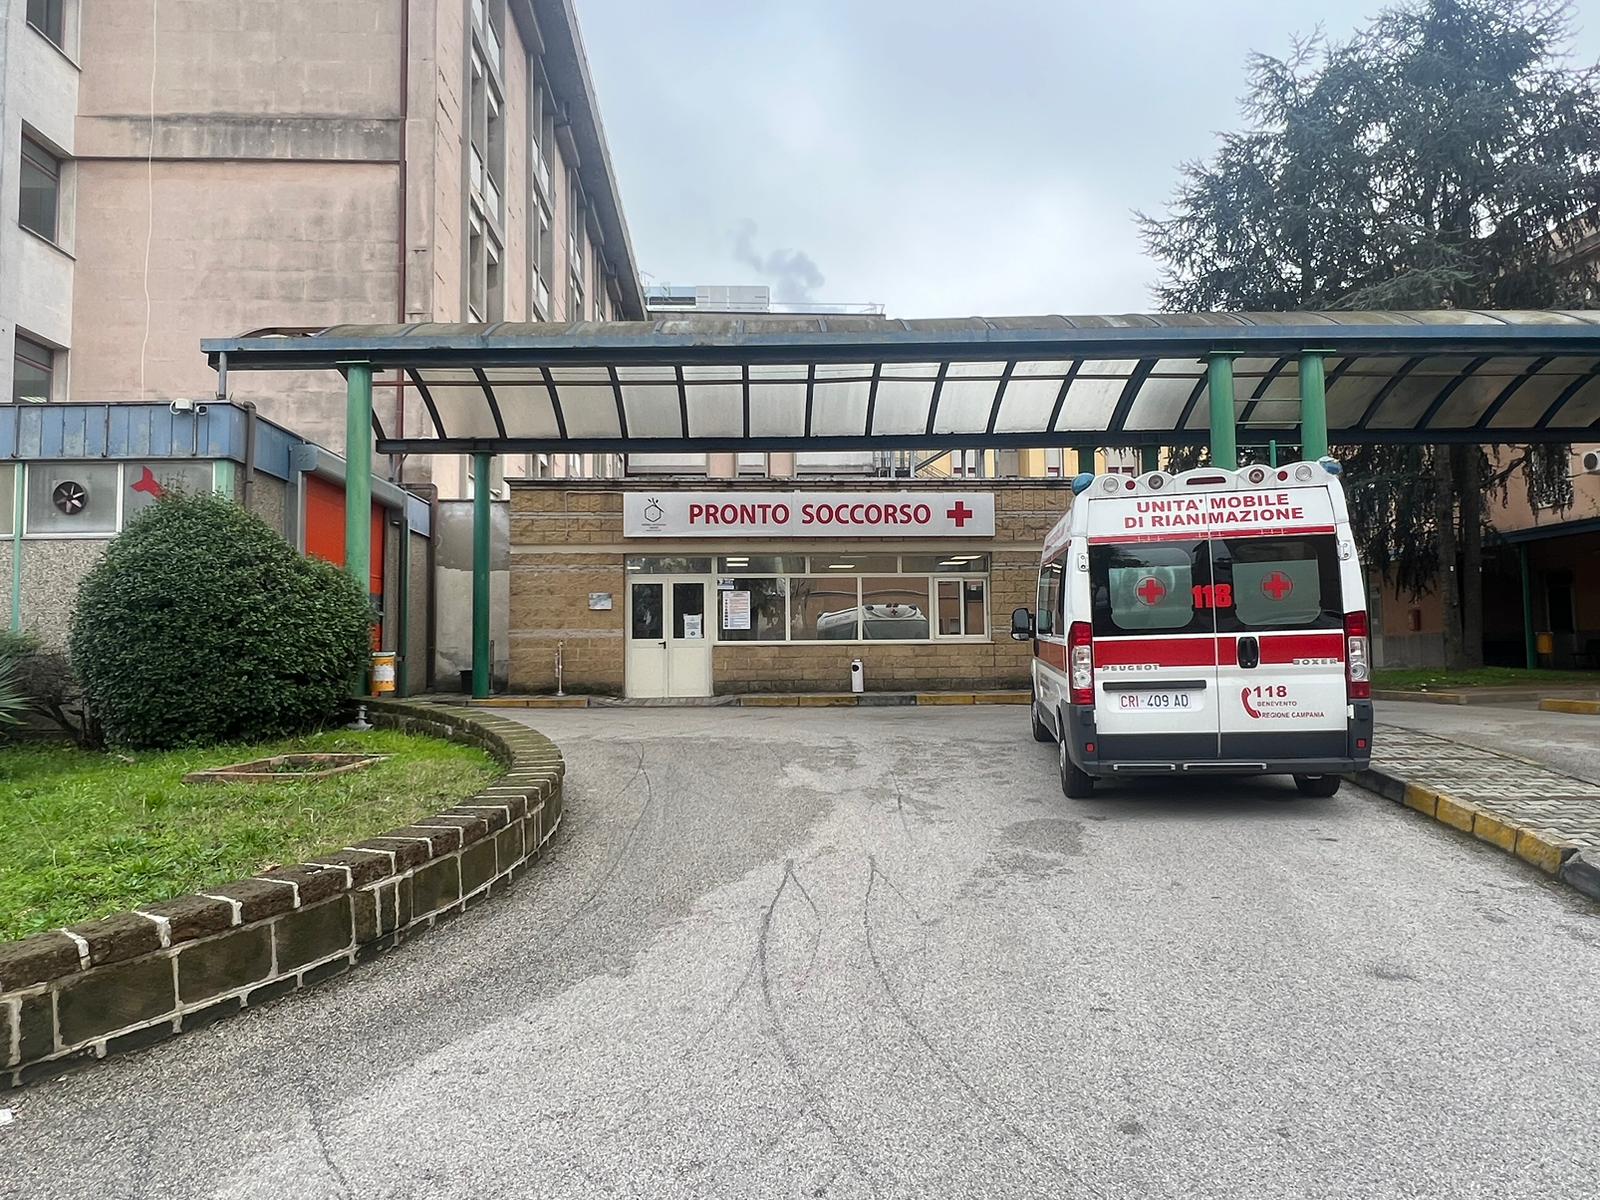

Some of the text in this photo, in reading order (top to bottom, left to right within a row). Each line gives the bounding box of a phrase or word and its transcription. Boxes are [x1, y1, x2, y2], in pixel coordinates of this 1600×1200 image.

[1136, 494, 1290, 513] UNITA' MOBILE
[688, 503, 932, 525] PRONTO SOCCORSO
[1124, 507, 1304, 529] DI RIANIMAZIONE
[1192, 583, 1232, 609] 118
[1102, 664, 1159, 672] PEUGEOT
[1293, 658, 1338, 666] BOXER
[1252, 685, 1288, 698] 118
[1120, 693, 1189, 708] CRI 409 AD
[1262, 711, 1325, 719] REGIONE CAMPANIA
